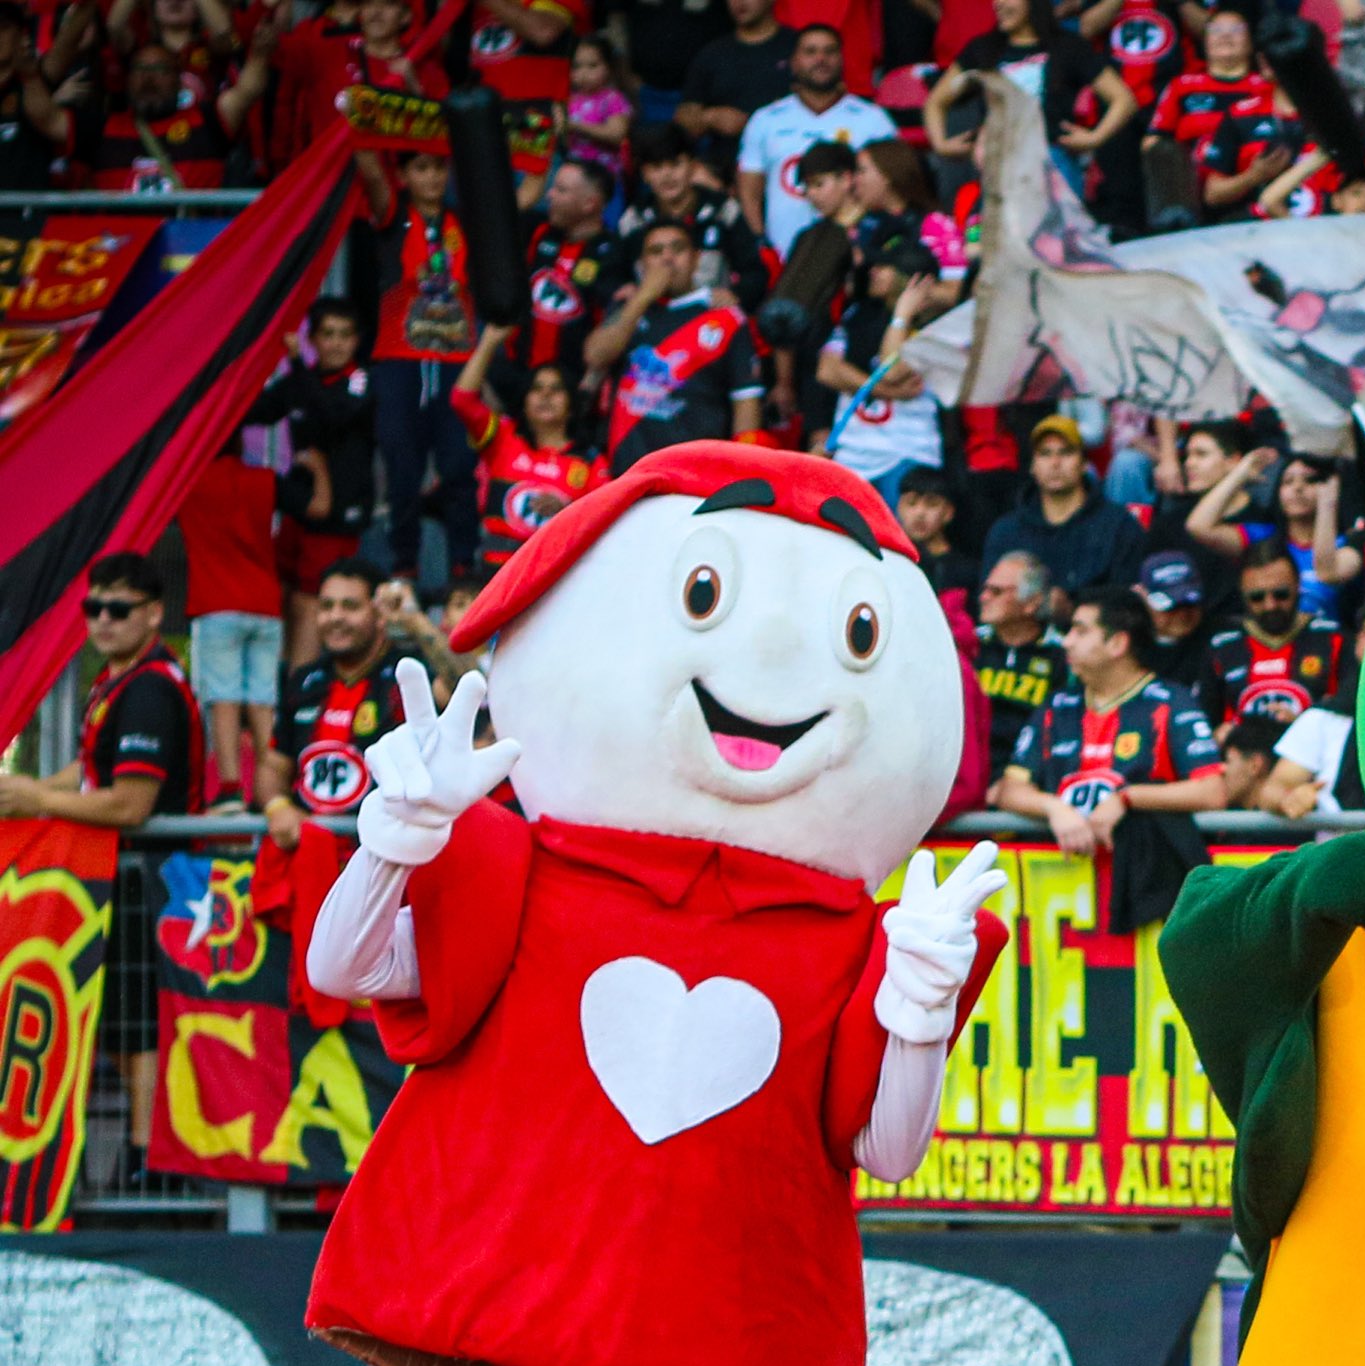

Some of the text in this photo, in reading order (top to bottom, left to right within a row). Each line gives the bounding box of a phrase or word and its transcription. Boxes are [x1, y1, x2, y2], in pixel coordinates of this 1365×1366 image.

[312, 757, 348, 796] PF
[0, 975, 55, 1127] R
[1050, 1143, 1107, 1206] LA
